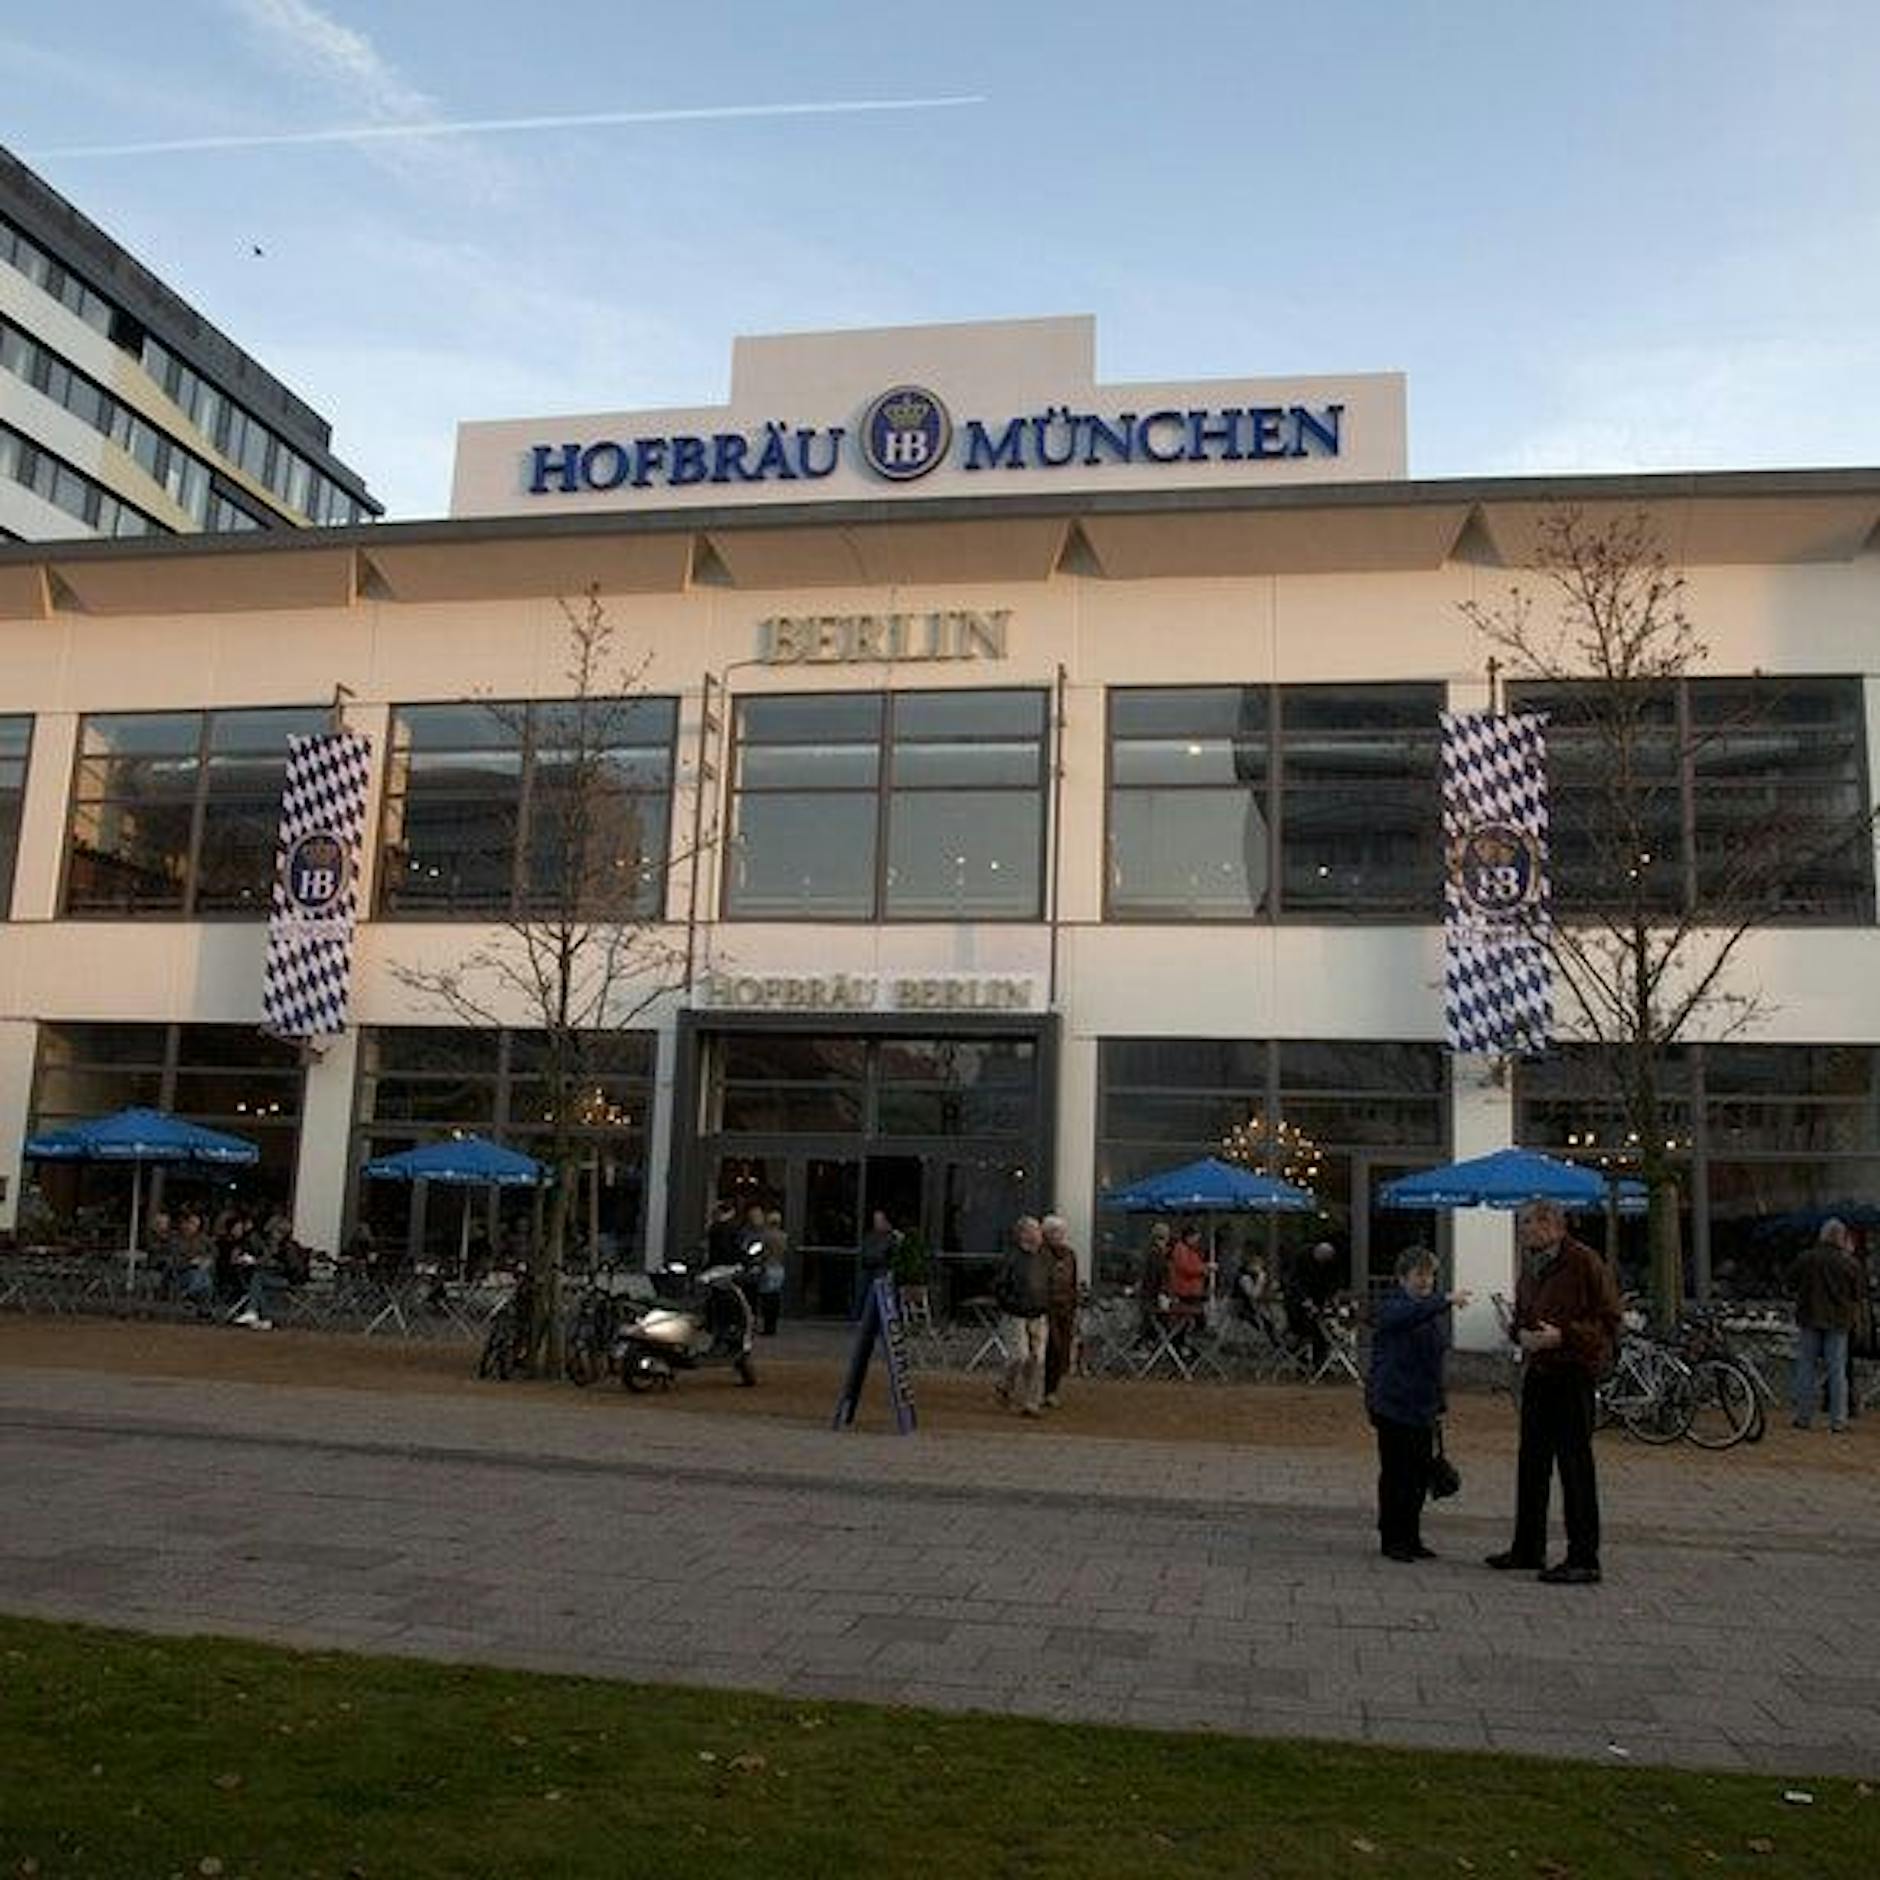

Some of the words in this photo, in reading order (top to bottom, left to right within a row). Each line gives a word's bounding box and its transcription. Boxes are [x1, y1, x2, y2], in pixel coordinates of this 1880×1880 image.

[529, 421, 845, 494] HOFBRÄU
[886, 429, 927, 463] HB
[963, 405, 1345, 471] MÜNCHEN
[756, 609, 1014, 664] BERLIN
[698, 971, 879, 1008] HOFBRÄU
[895, 977, 1034, 1010] BERLIN
